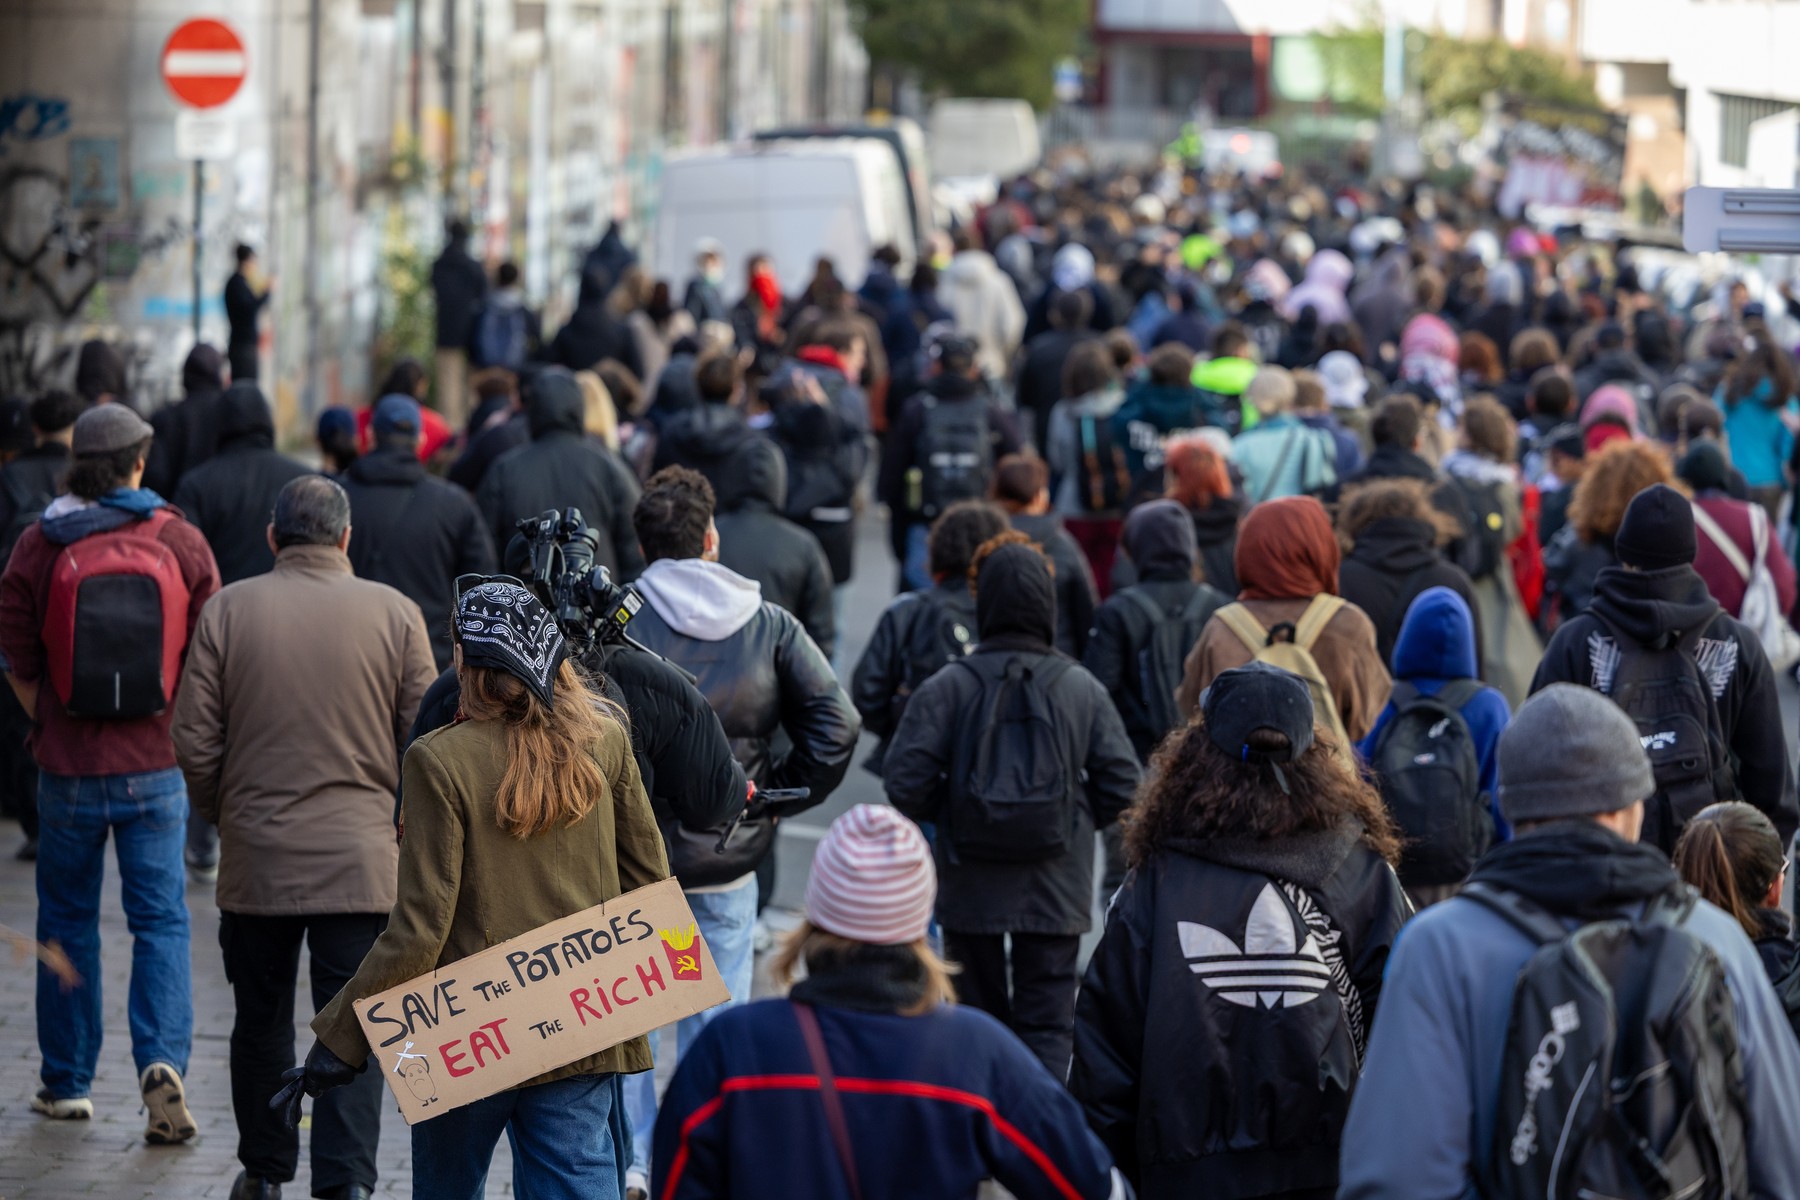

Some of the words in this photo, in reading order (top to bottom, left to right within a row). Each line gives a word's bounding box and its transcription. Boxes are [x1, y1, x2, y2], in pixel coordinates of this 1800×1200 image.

[367, 979, 466, 1048] SAVE
[473, 980, 512, 1002] THE
[506, 909, 654, 988] POTATOES
[438, 1018, 511, 1078] EAT
[528, 1019, 564, 1040] THE
